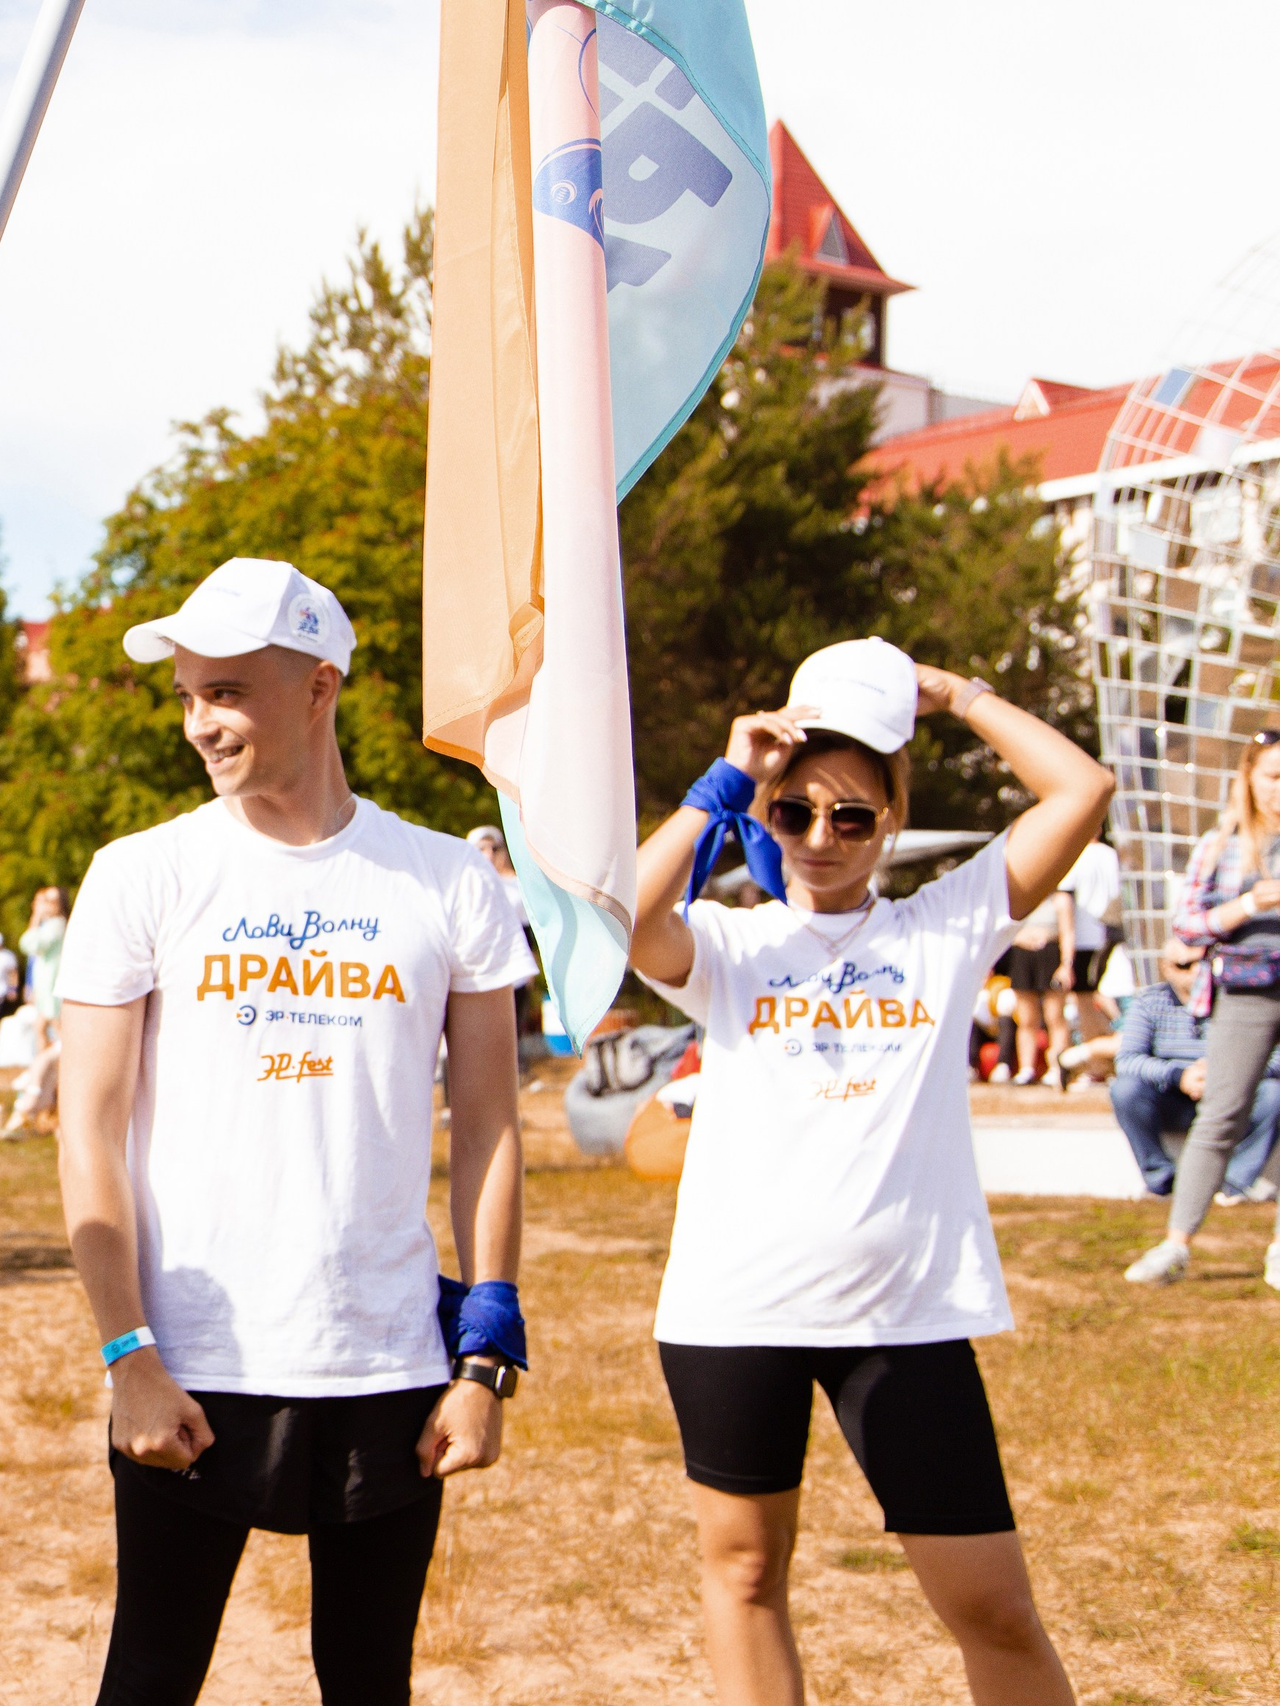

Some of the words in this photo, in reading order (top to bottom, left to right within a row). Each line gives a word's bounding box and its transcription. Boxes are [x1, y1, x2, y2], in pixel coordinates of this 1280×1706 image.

[222, 913, 294, 942] Лови
[289, 911, 381, 950] Волну
[197, 949, 406, 1003] ДРАЙВА
[747, 988, 936, 1036] ДРАЙВА
